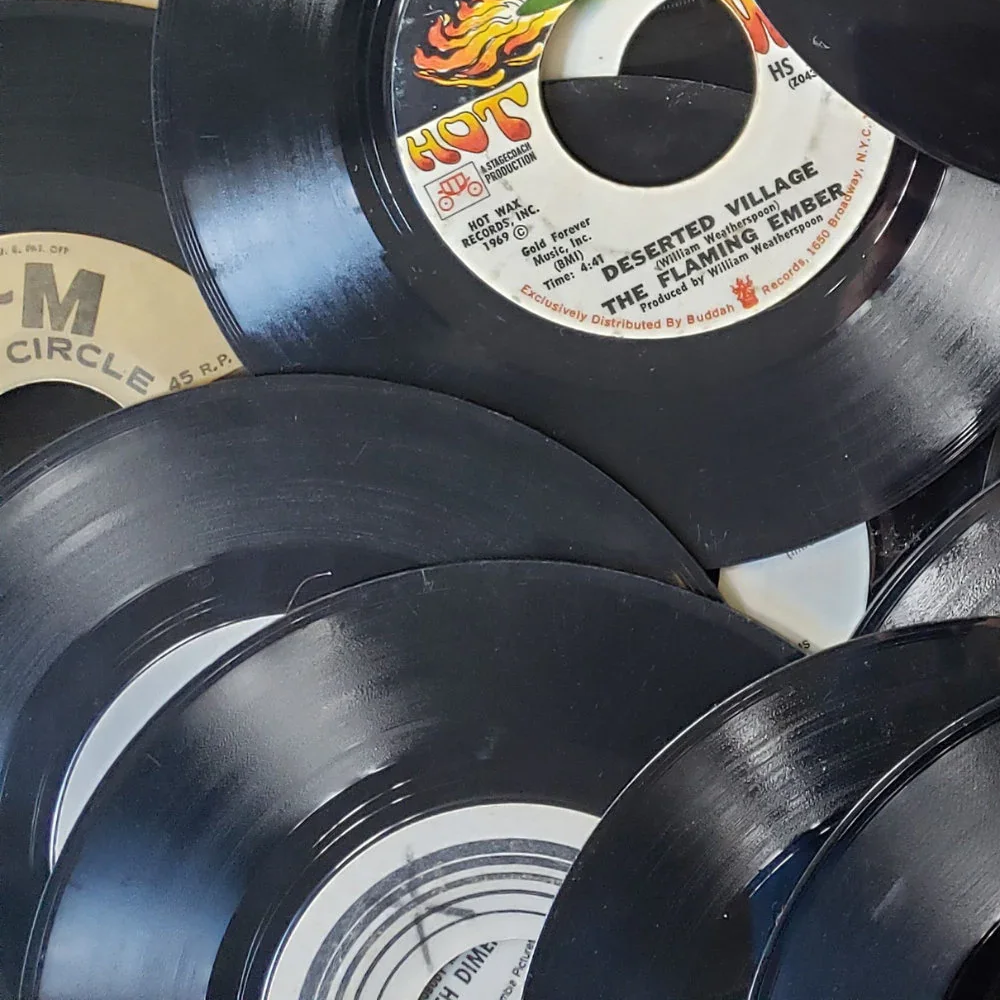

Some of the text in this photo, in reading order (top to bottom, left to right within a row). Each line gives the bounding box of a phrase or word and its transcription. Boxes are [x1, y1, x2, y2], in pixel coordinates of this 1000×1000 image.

[767, 57, 794, 82] HS
[406, 81, 532, 171] HOT
[484, 151, 537, 184] PRODUCTION
[486, 142, 532, 171] STAGECOACH
[461, 204, 540, 249] RECORDS, INC.
[467, 198, 523, 232] HOT WAX
[601, 161, 819, 282] DESERTED VILLAGE
[483, 232, 510, 251] 1969
[520, 284, 588, 322] Exclusively
[591, 315, 662, 330] Distributed
[666, 317, 683, 329] By
[687, 304, 735, 324] Buddah
[761, 259, 809, 295] Records,
[807, 229, 831, 256] 1650
[828, 167, 864, 229] Broadway,
[521, 217, 591, 257] Gold Forever
[533, 235, 592, 267] Music, Inc.
[600, 182, 846, 316] THE FLAMING EMBER
[654, 200, 780, 271] (William Weatherspoon)
[543, 253, 605, 290] Time: 4:41
[554, 249, 585, 273] (BMI)
[639, 213, 824, 313] Produced by William Weatherspoon
[6, 337, 156, 395] CIRCLE
[169, 370, 193, 392] 45
